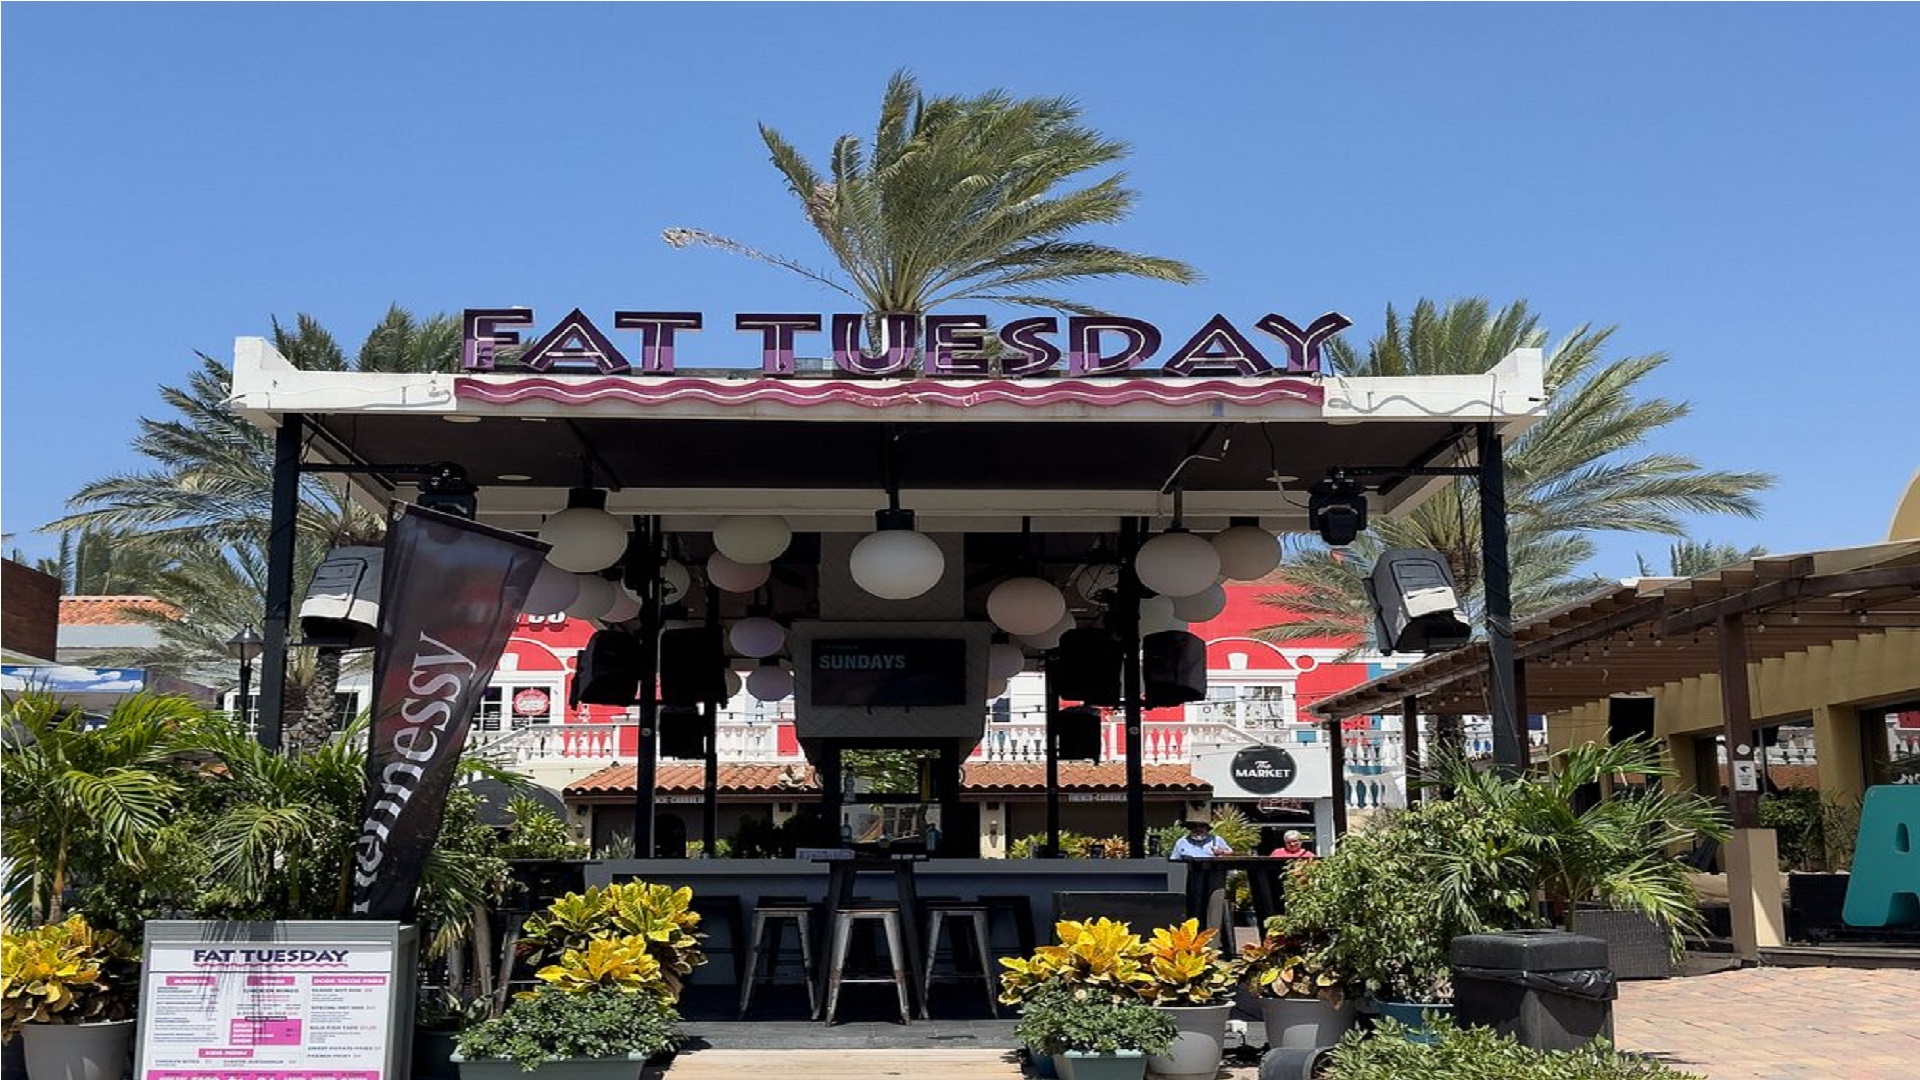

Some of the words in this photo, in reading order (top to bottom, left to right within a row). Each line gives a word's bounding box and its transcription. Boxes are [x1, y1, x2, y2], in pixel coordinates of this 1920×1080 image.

[463, 308, 703, 373] FAT
[736, 312, 1353, 377] TUESDAY
[819, 654, 906, 669] SUNDAYS
[1235, 769, 1292, 778] MARKET
[194, 950, 236, 962] FAT
[240, 950, 349, 962] TUESDAY
